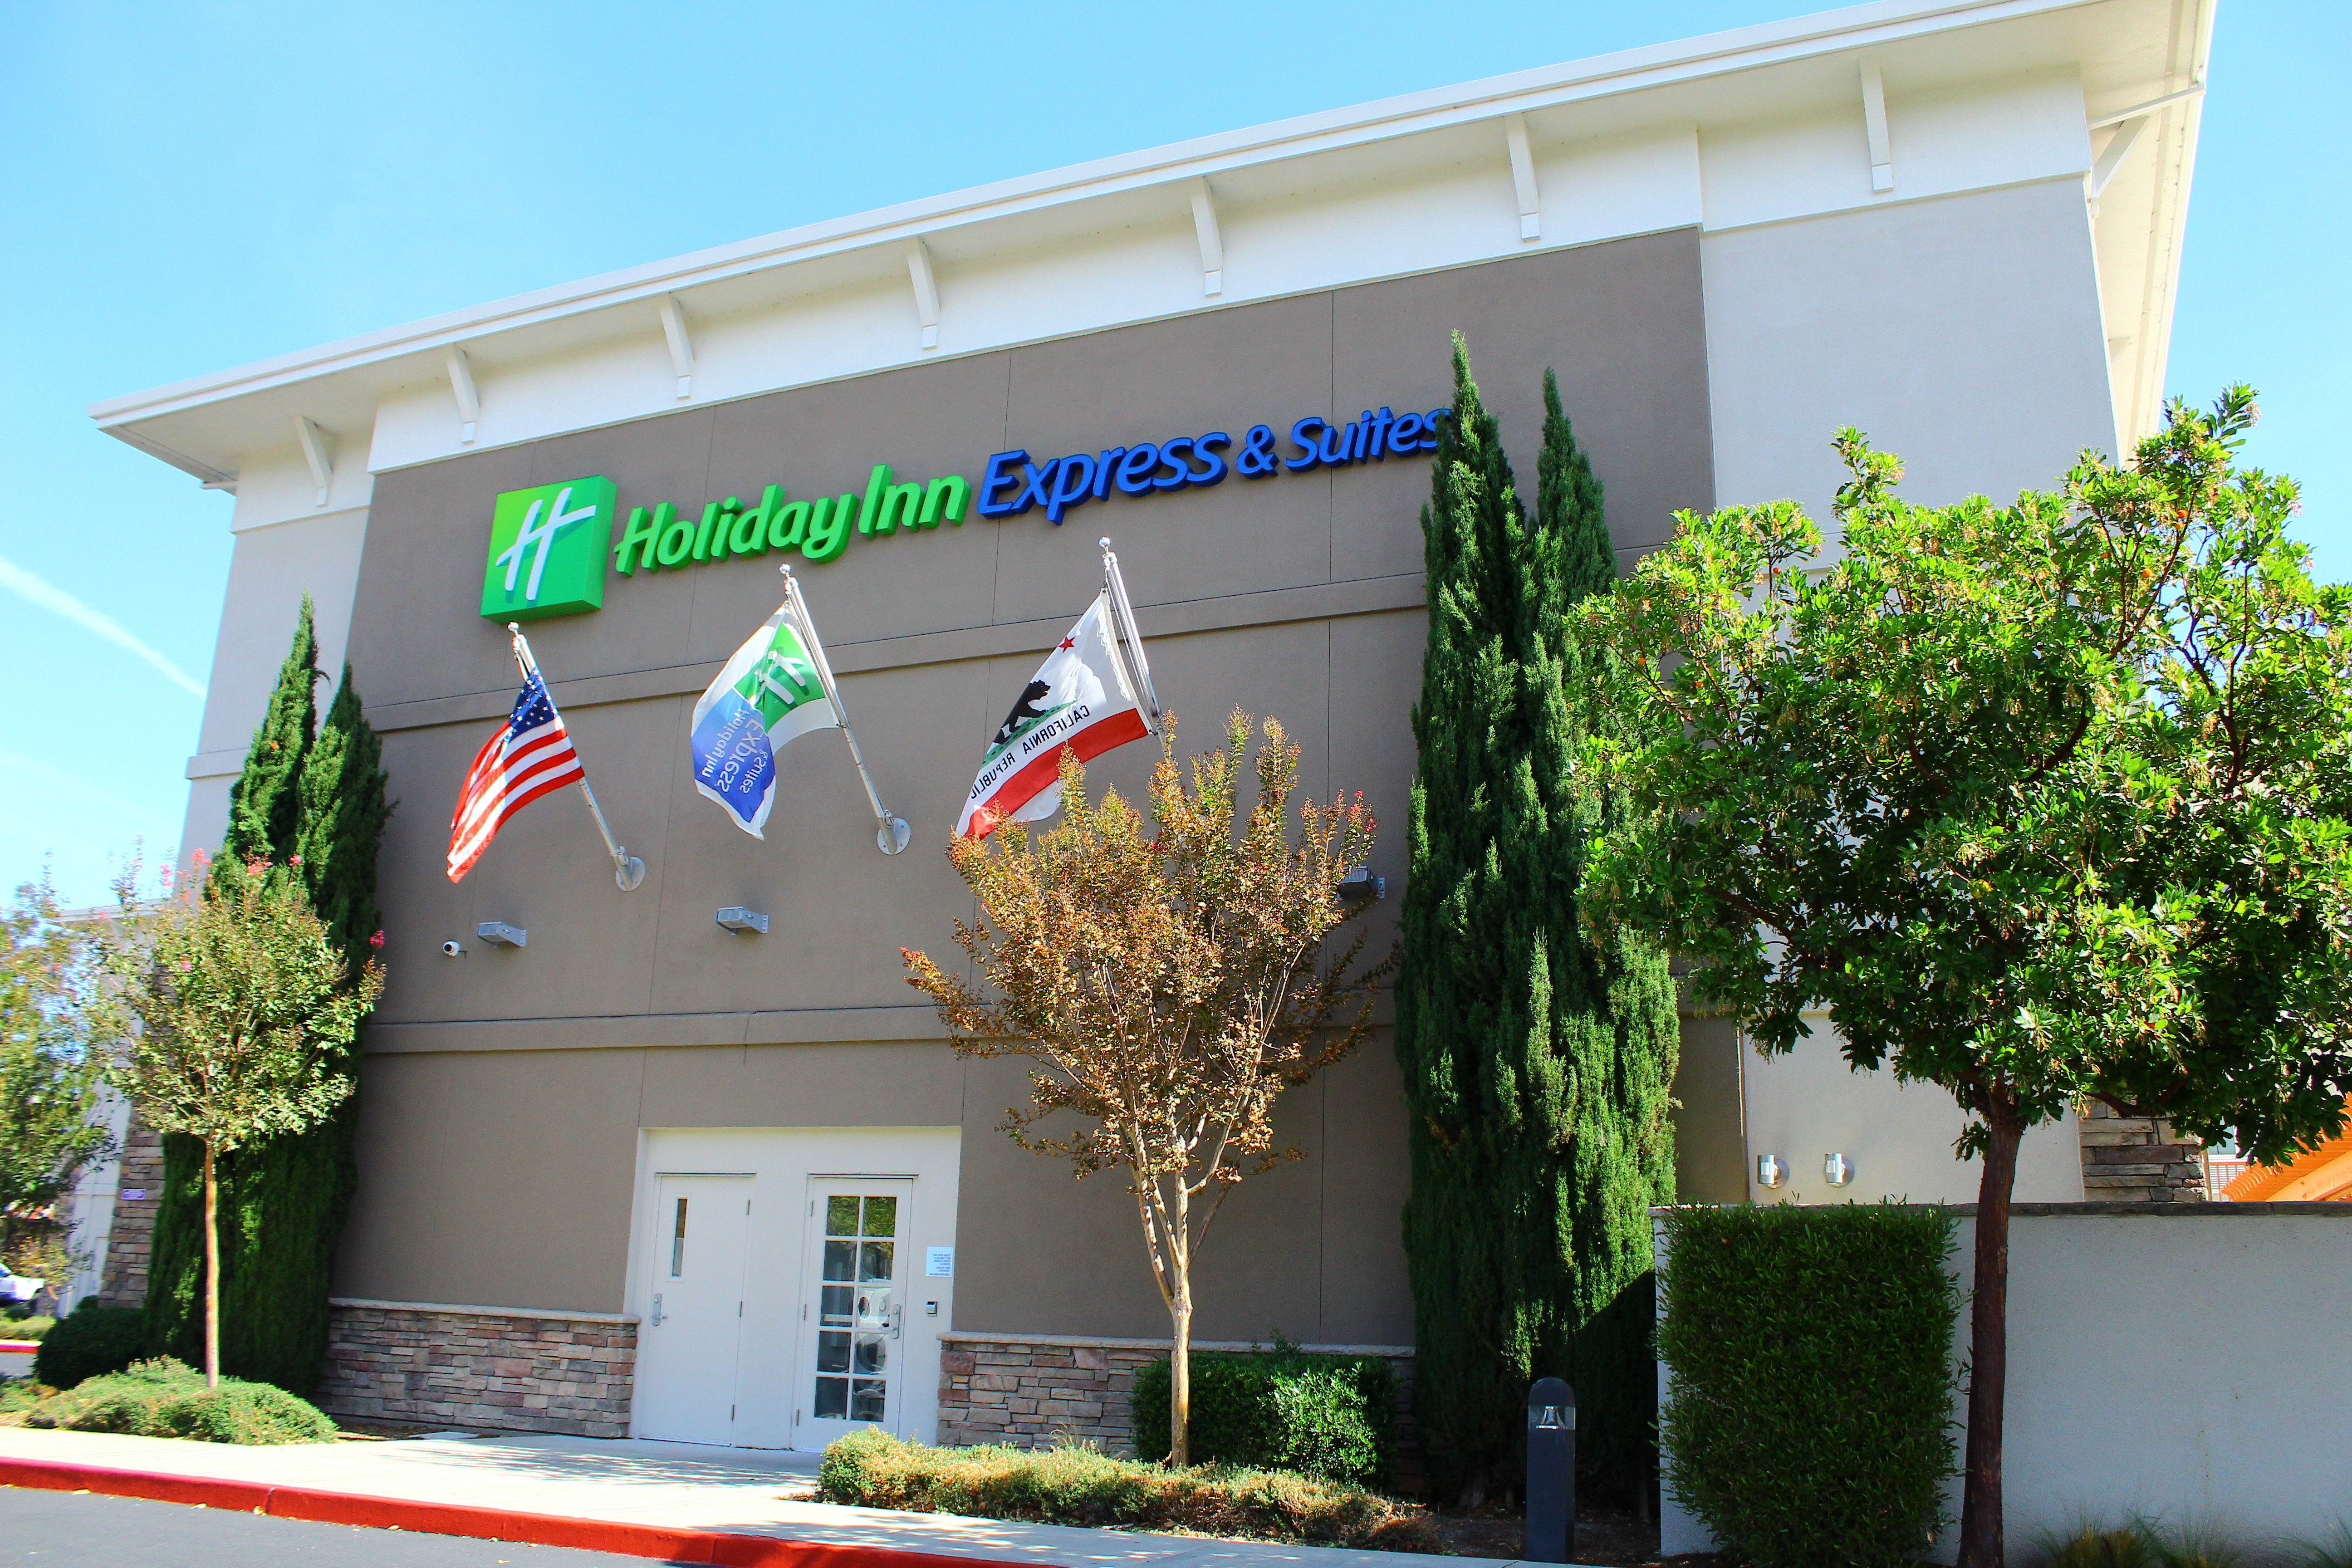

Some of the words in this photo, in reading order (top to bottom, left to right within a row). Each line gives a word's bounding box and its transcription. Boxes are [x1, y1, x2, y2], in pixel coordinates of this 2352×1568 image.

[613, 484, 859, 577] Holiday
[858, 464, 971, 538] Inn
[976, 431, 1232, 526] Express
[1236, 424, 1279, 480] &
